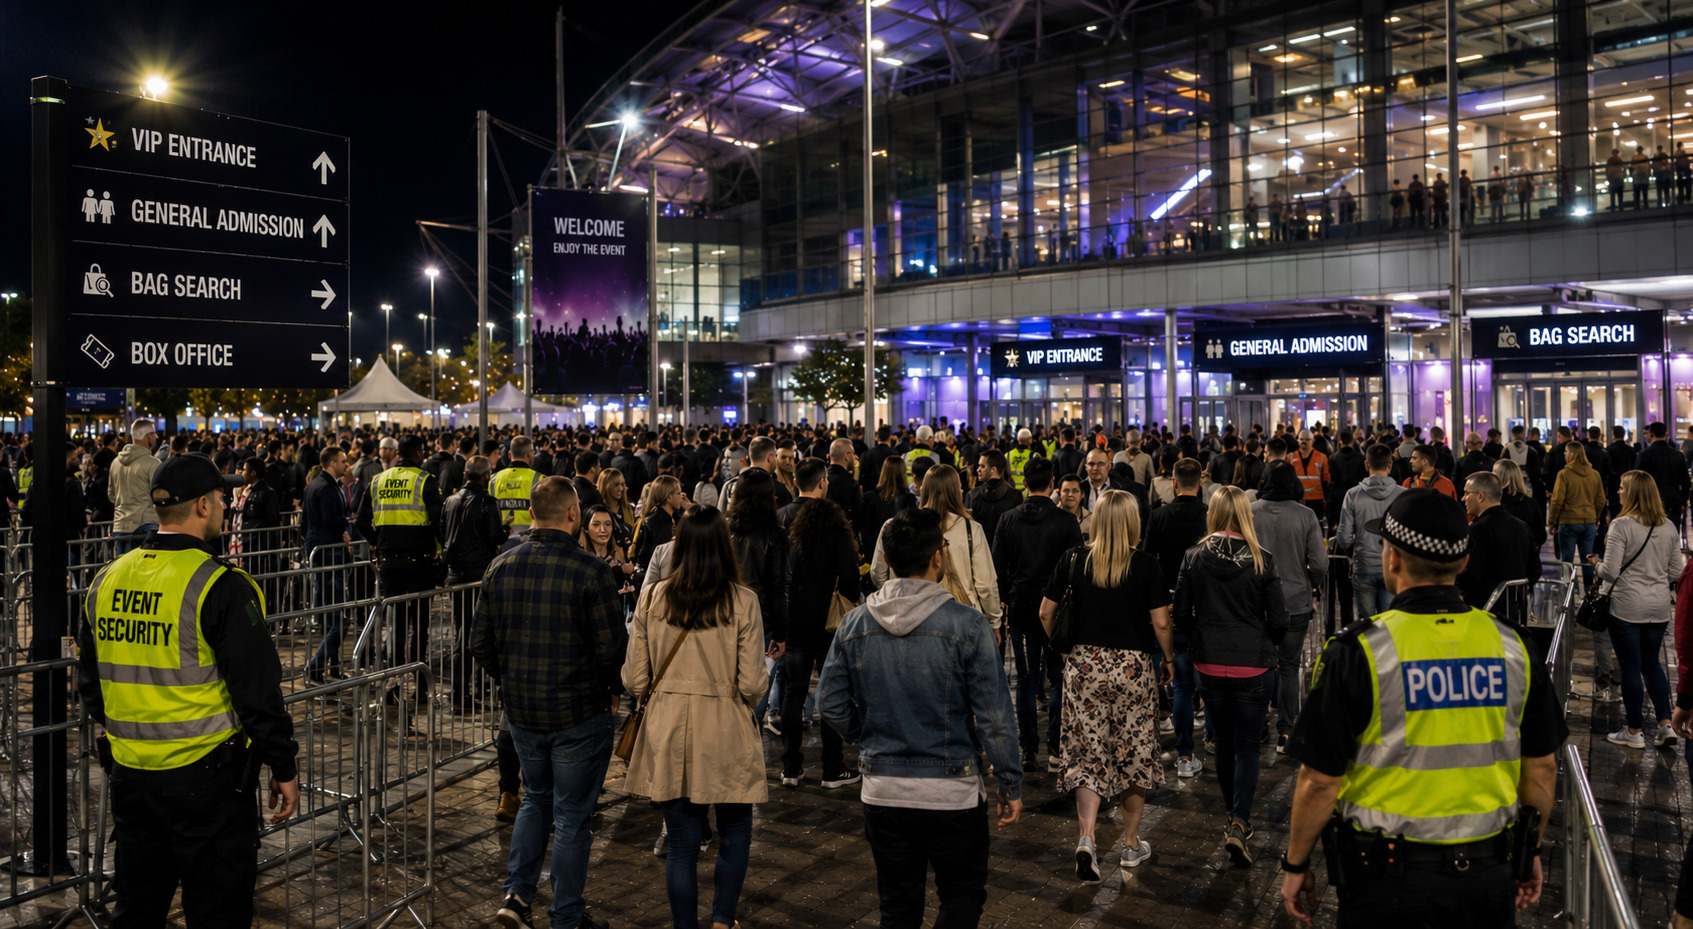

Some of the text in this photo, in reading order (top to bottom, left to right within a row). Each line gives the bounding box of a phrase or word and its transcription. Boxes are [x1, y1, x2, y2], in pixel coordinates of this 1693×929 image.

[132, 128, 256, 167] VIP ENTRANCE
[132, 200, 303, 238] GENERAL ADMISSION
[554, 217, 624, 237] WELCOME
[553, 243, 626, 256] ENJOY THE EVENT
[132, 272, 240, 299] BAG SEARCH
[1231, 335, 1367, 356] GENERAL ADMISSION
[1530, 325, 1634, 345] BAG SEARCH
[132, 342, 232, 365] BOX OFFICE
[1027, 347, 1102, 364] VIP ENTRANCE
[379, 489, 411, 499] SECURITY
[384, 479, 408, 488] EVENT
[112, 589, 163, 615] EVENT
[98, 618, 173, 646] SECURITY
[1407, 665, 1503, 703] POLICE
